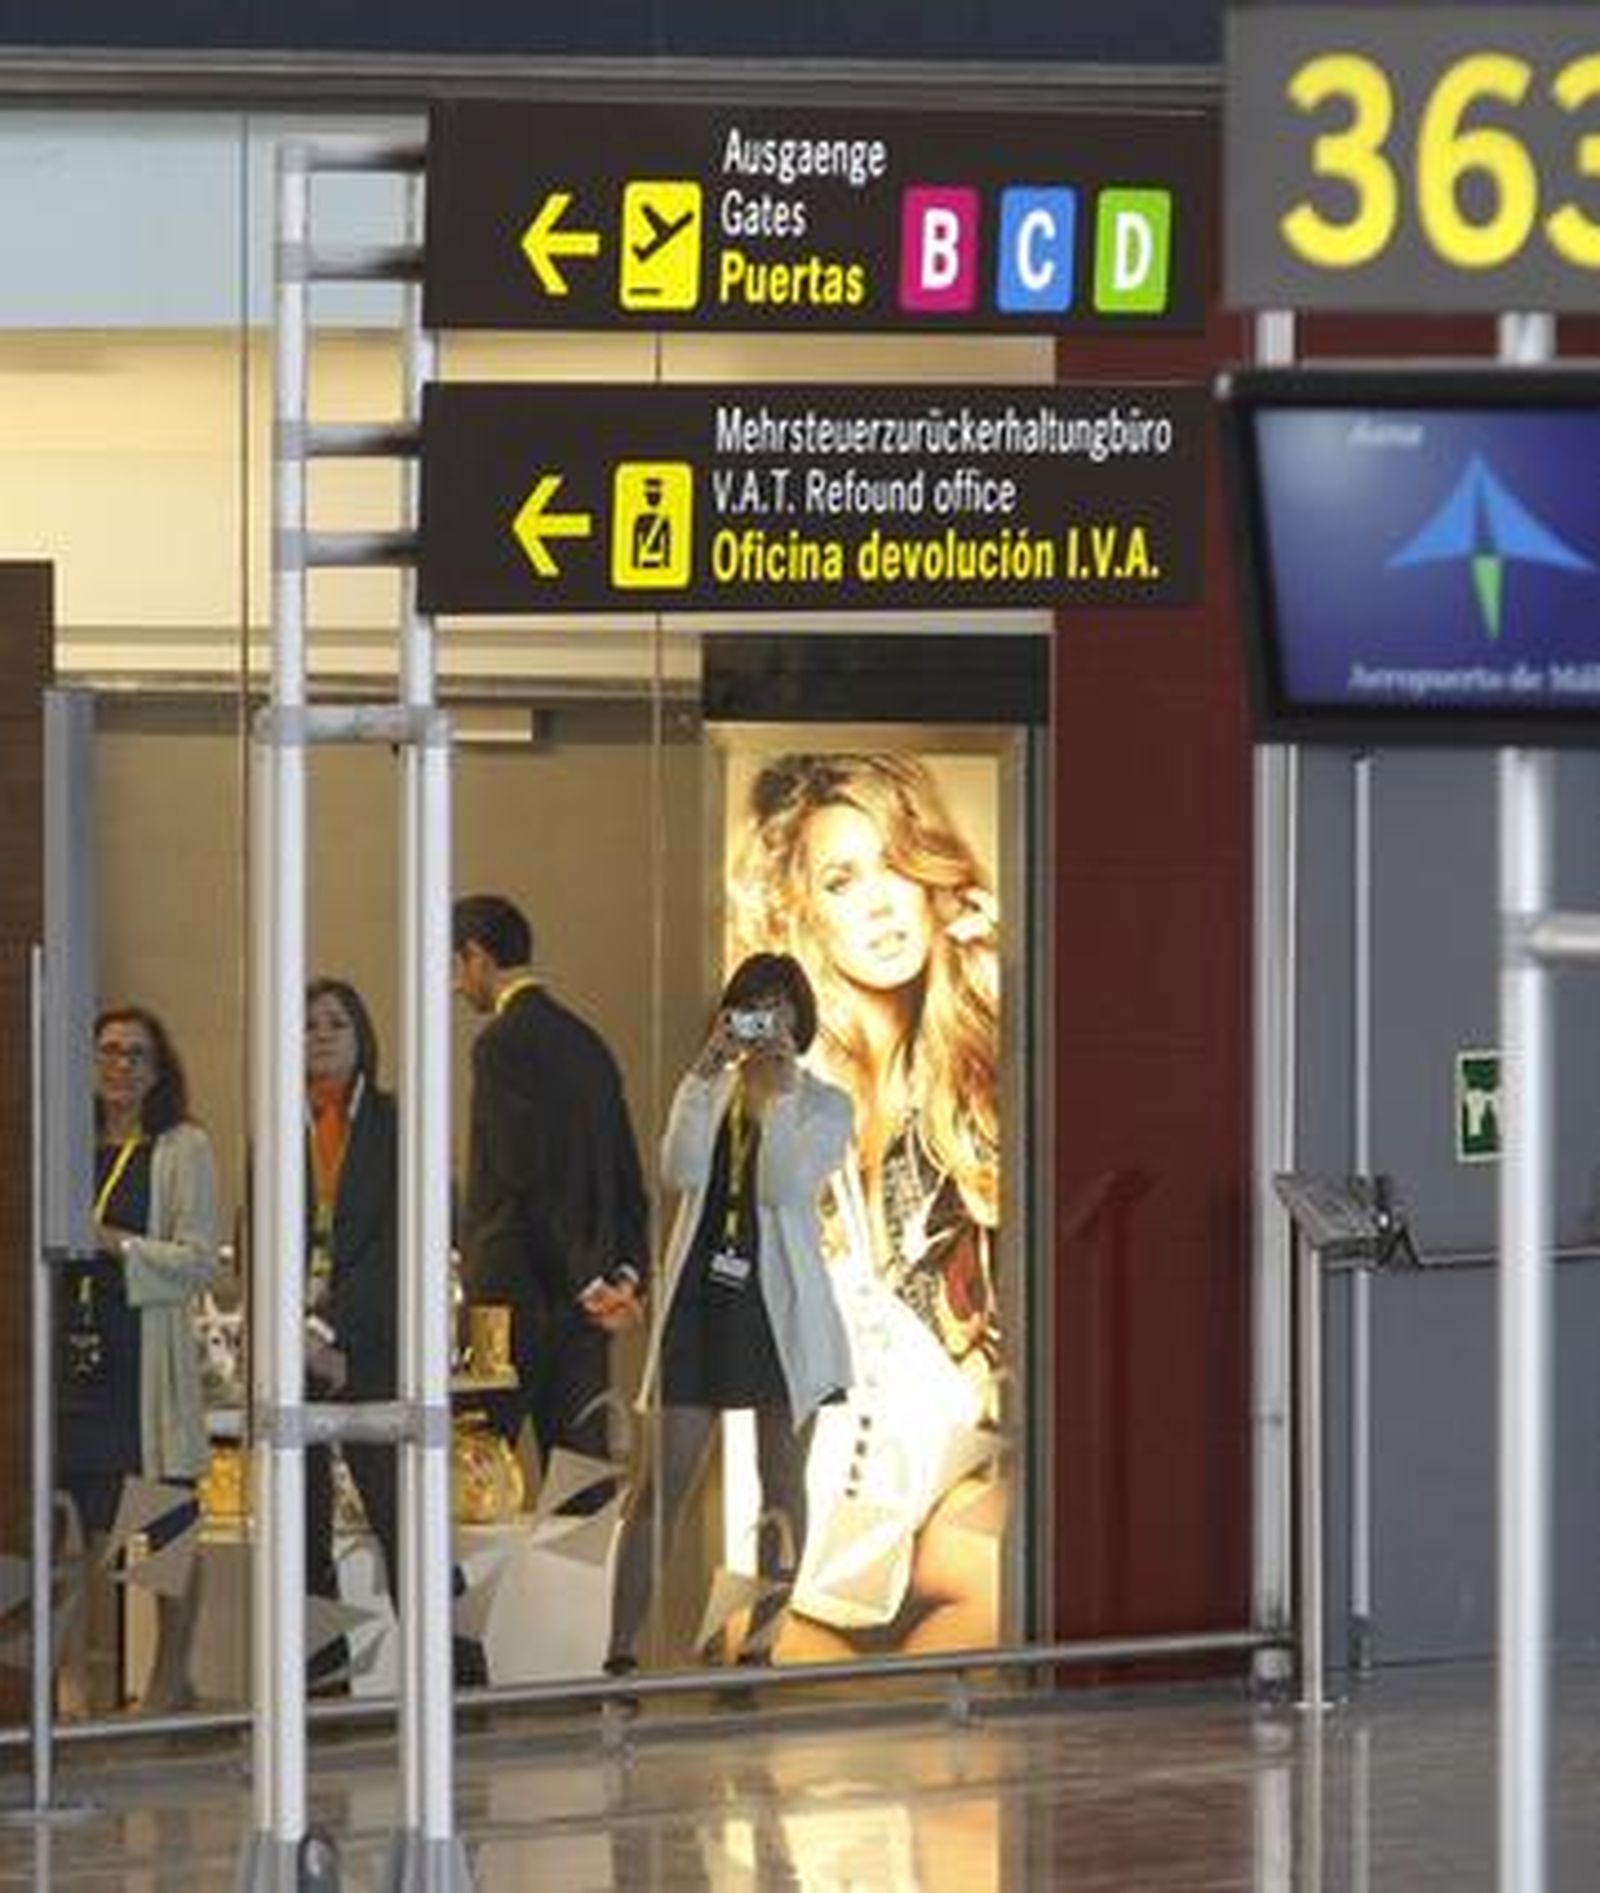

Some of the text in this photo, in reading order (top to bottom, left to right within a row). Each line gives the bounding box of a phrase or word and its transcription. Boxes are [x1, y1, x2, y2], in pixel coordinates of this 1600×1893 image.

[722, 128, 887, 185] Ausgaenge
[720, 188, 807, 237] Gates
[719, 249, 865, 304] Puertas
[921, 207, 1153, 291] B C D
[715, 406, 1173, 463] Mehrsteuerzurückerhaltungbüro
[712, 468, 1016, 514] V.A.T. Refound office
[712, 525, 1160, 583] Oficina devolución I.V.A.
